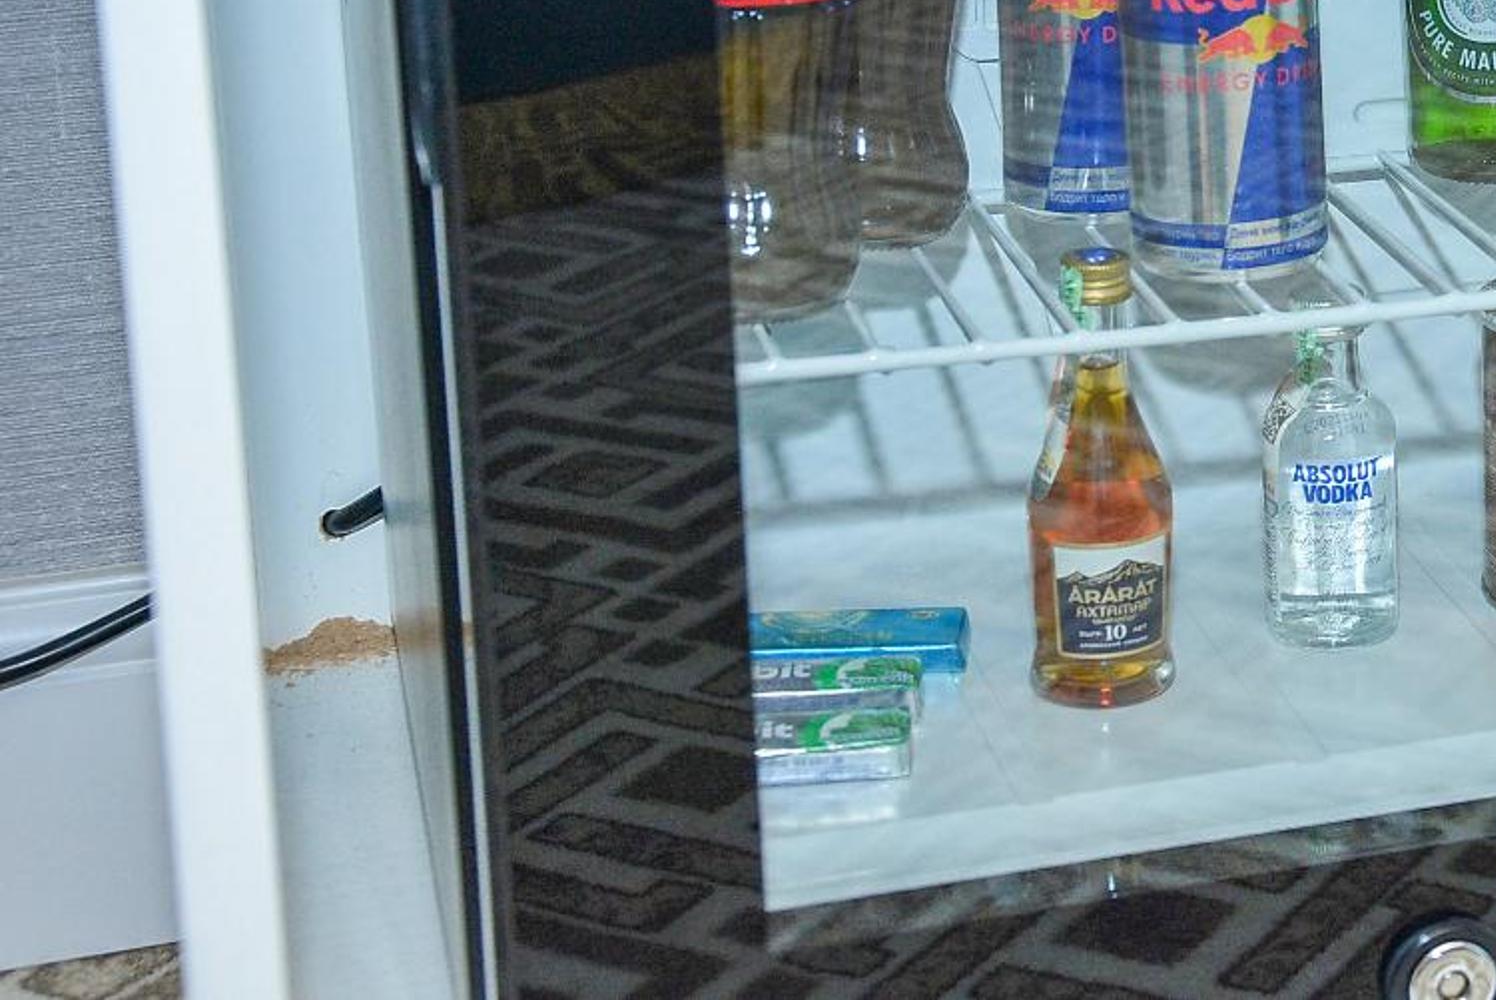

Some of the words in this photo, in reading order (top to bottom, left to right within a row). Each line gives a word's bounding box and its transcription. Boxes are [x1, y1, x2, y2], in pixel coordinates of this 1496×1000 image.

[1420, 10, 1454, 59] PURE
[1292, 455, 1382, 483] ABSOLUT
[1302, 480, 1374, 504] VODKA
[1068, 578, 1158, 605] ARARAT
[1105, 623, 1128, 641] 10
